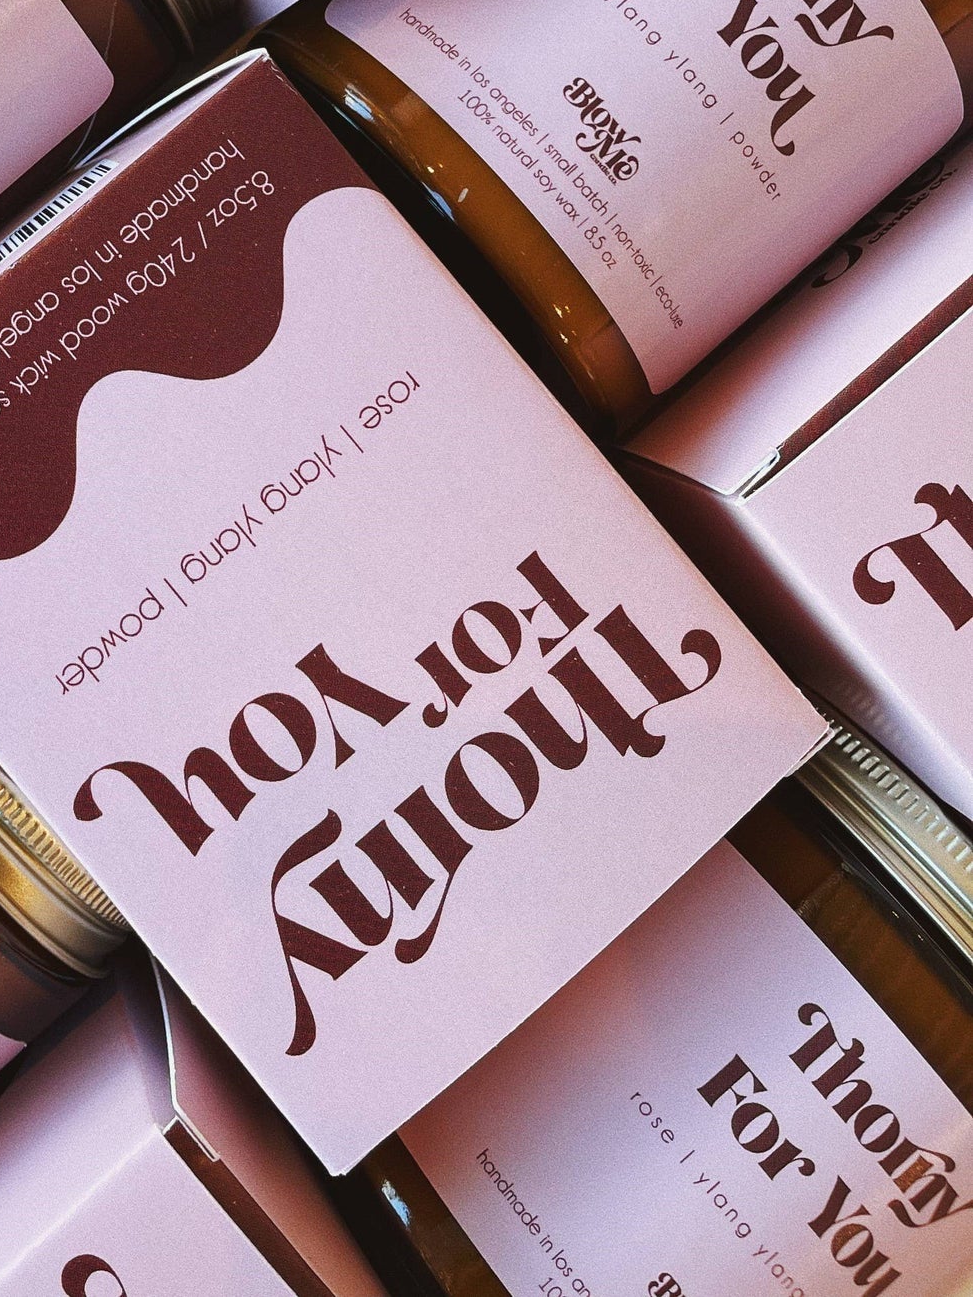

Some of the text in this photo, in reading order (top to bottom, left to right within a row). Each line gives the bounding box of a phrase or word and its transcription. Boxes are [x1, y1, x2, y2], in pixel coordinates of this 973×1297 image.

[399, 7, 460, 60] handmade
[469, 65, 490, 88] los
[489, 87, 539, 137] angeles
[543, 143, 579, 177] small
[571, 171, 609, 217] batch
[563, 77, 641, 145] Blow
[663, 49, 718, 109] ylang
[728, 130, 781, 200] powder
[119, 139, 245, 244] handmade
[205, 170, 275, 227] 8.5oz
[457, 89, 617, 270] 100% natural soy wax 8.5 oz
[60, 259, 102, 294] los
[94, 240, 123, 263] in
[125, 236, 196, 295] 240g
[9, 349, 61, 395] wick
[58, 292, 129, 360] wood
[55, 370, 420, 695] rose ylang ylang powder
[72, 550, 590, 856] For You
[271, 603, 722, 1056] Thorny
[476, 1148, 541, 1236] handmade
[539, 1234, 553, 1253] in
[551, 1248, 573, 1277] los
[629, 1091, 752, 1239] rose ylang
[697, 1054, 902, 1297] For You
